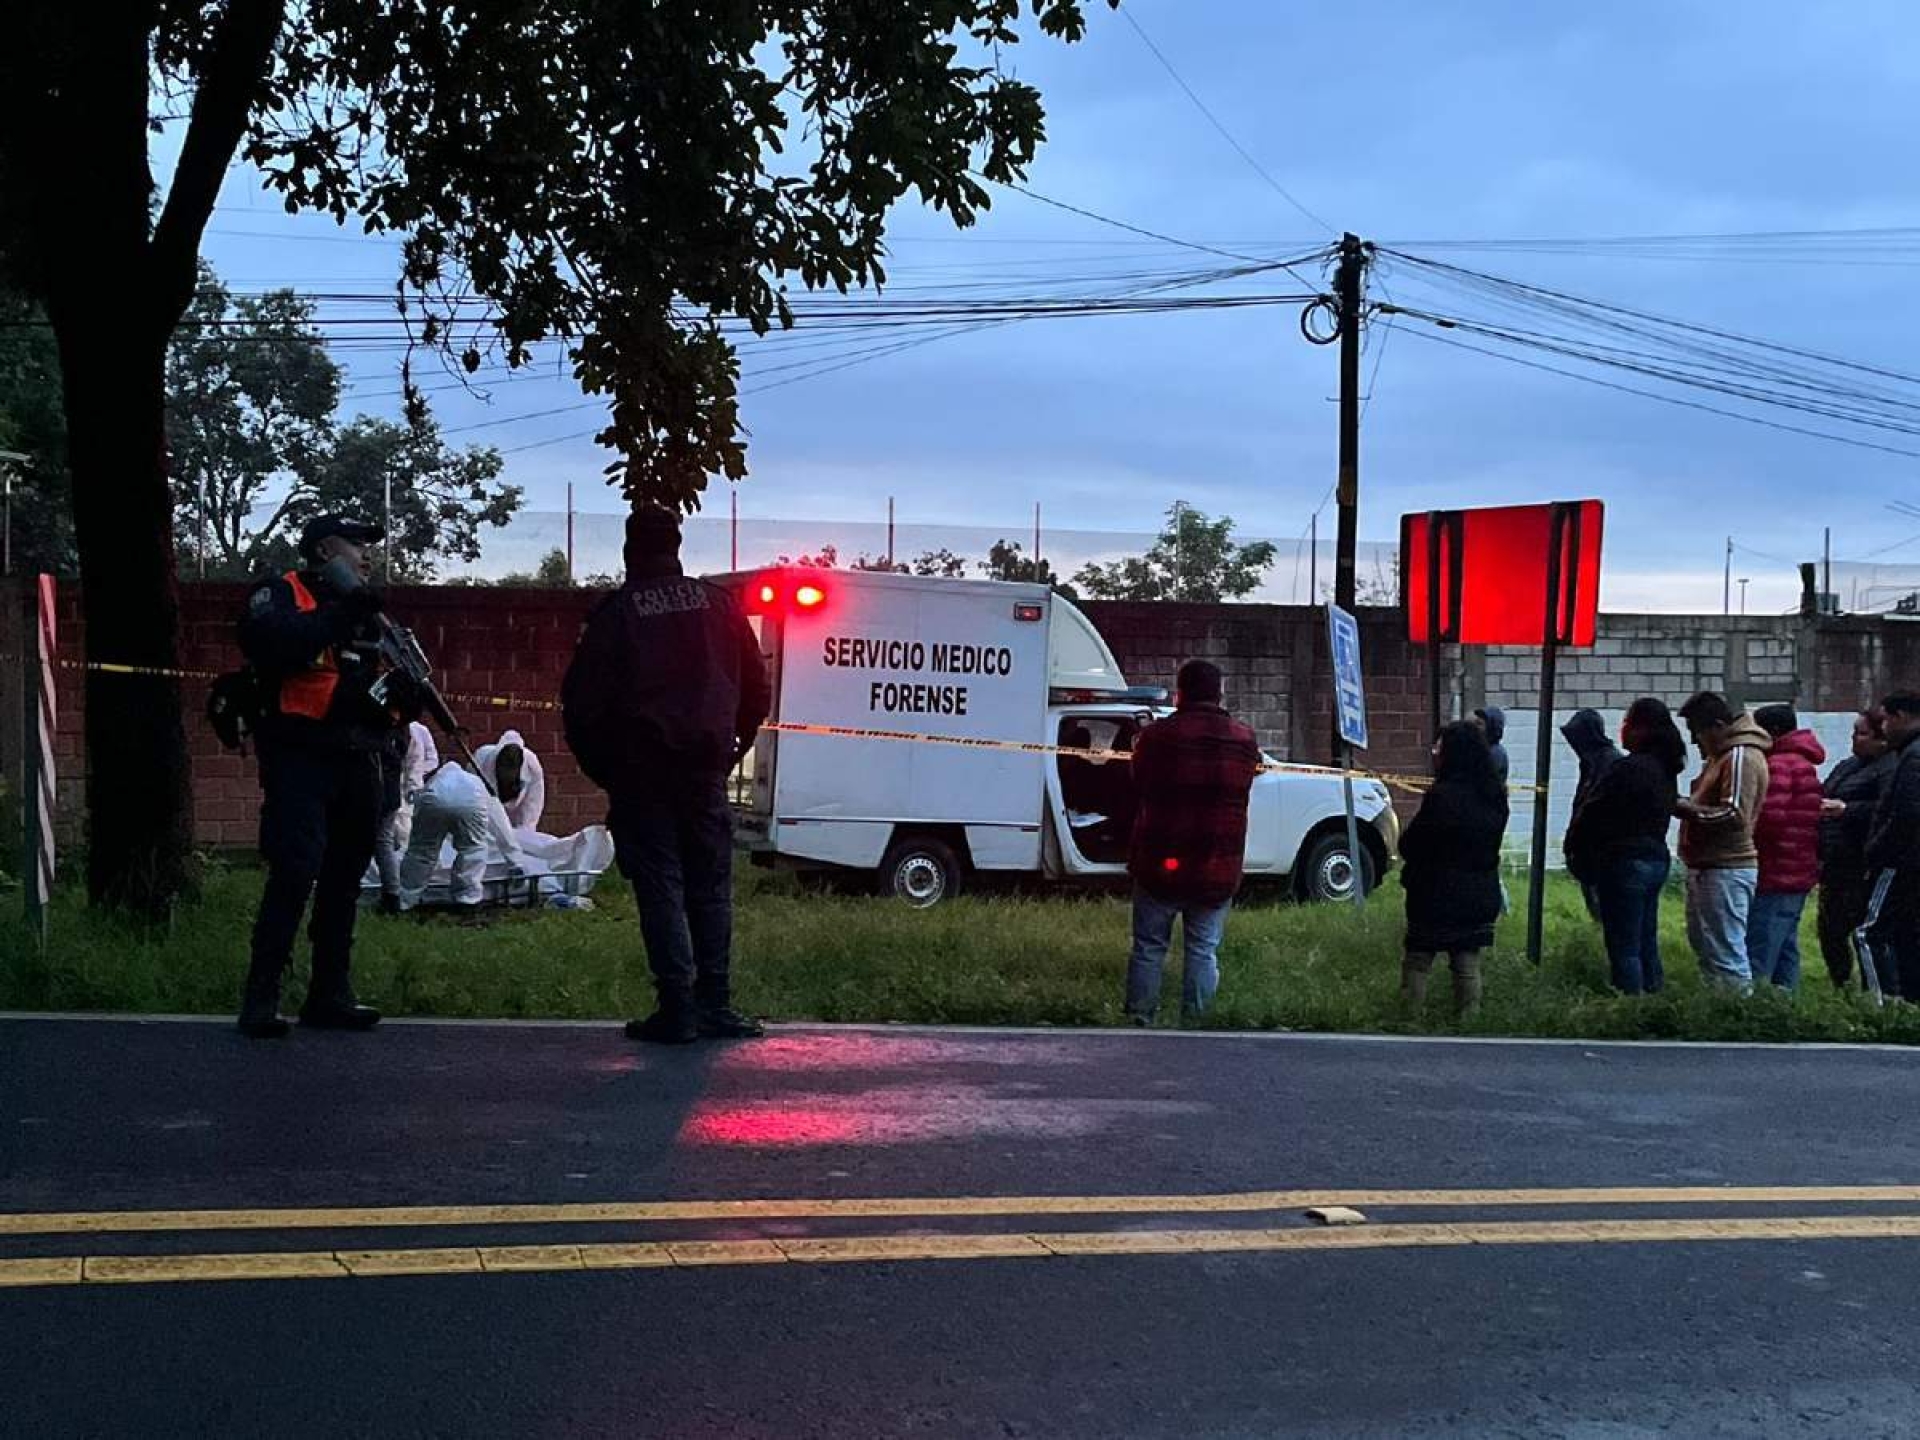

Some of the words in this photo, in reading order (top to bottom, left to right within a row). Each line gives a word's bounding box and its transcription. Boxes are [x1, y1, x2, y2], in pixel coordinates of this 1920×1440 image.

[823, 637, 925, 671] SERVICIO
[931, 642, 1012, 676] MEDICO
[870, 682, 968, 715] FORENSE
